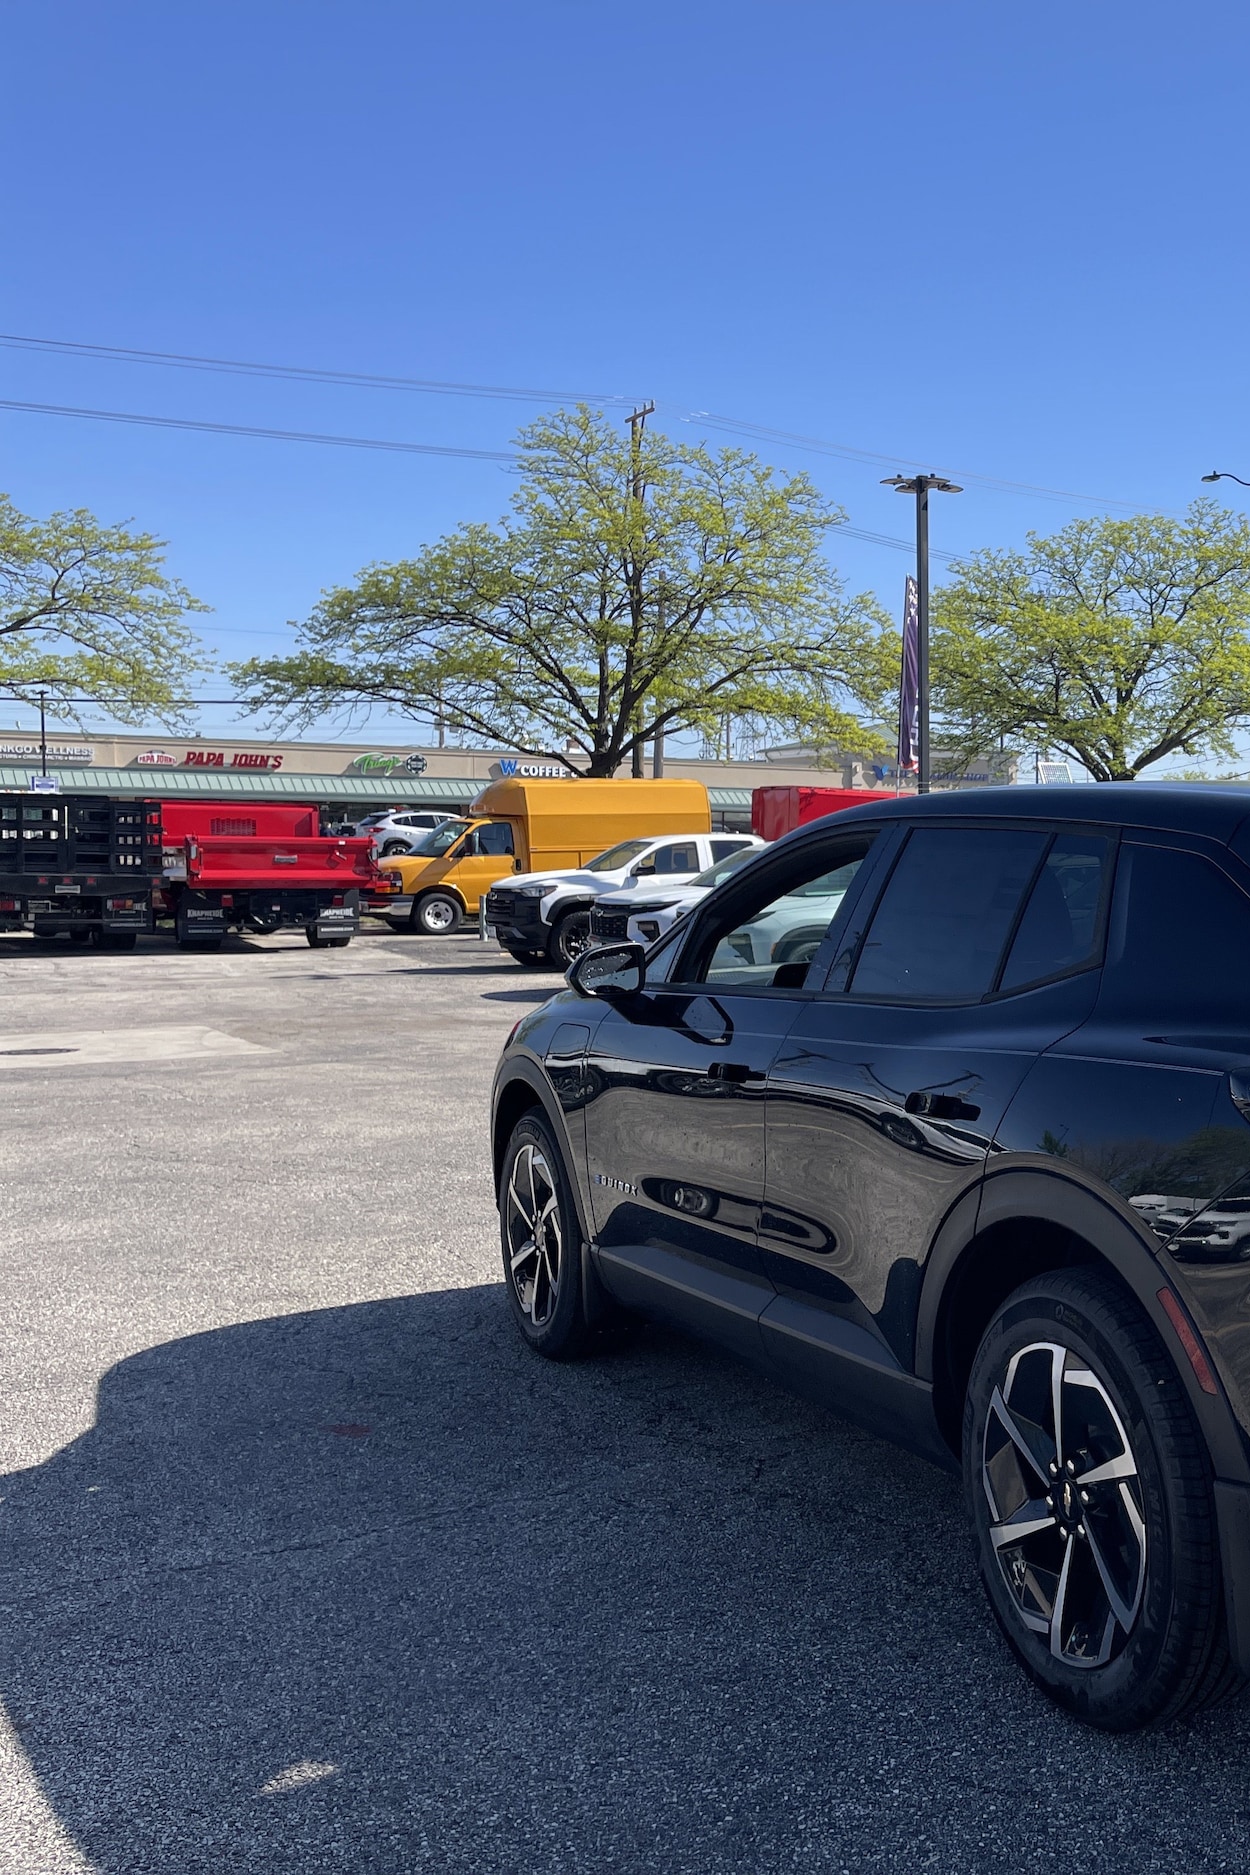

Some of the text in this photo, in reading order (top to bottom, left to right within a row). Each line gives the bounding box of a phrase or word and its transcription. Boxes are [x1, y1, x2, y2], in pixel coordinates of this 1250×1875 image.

[139, 755, 155, 764] PAPA
[184, 752, 283, 769] PAPA JOHN'S
[499, 759, 517, 776] W
[520, 765, 566, 777] COFFEE
